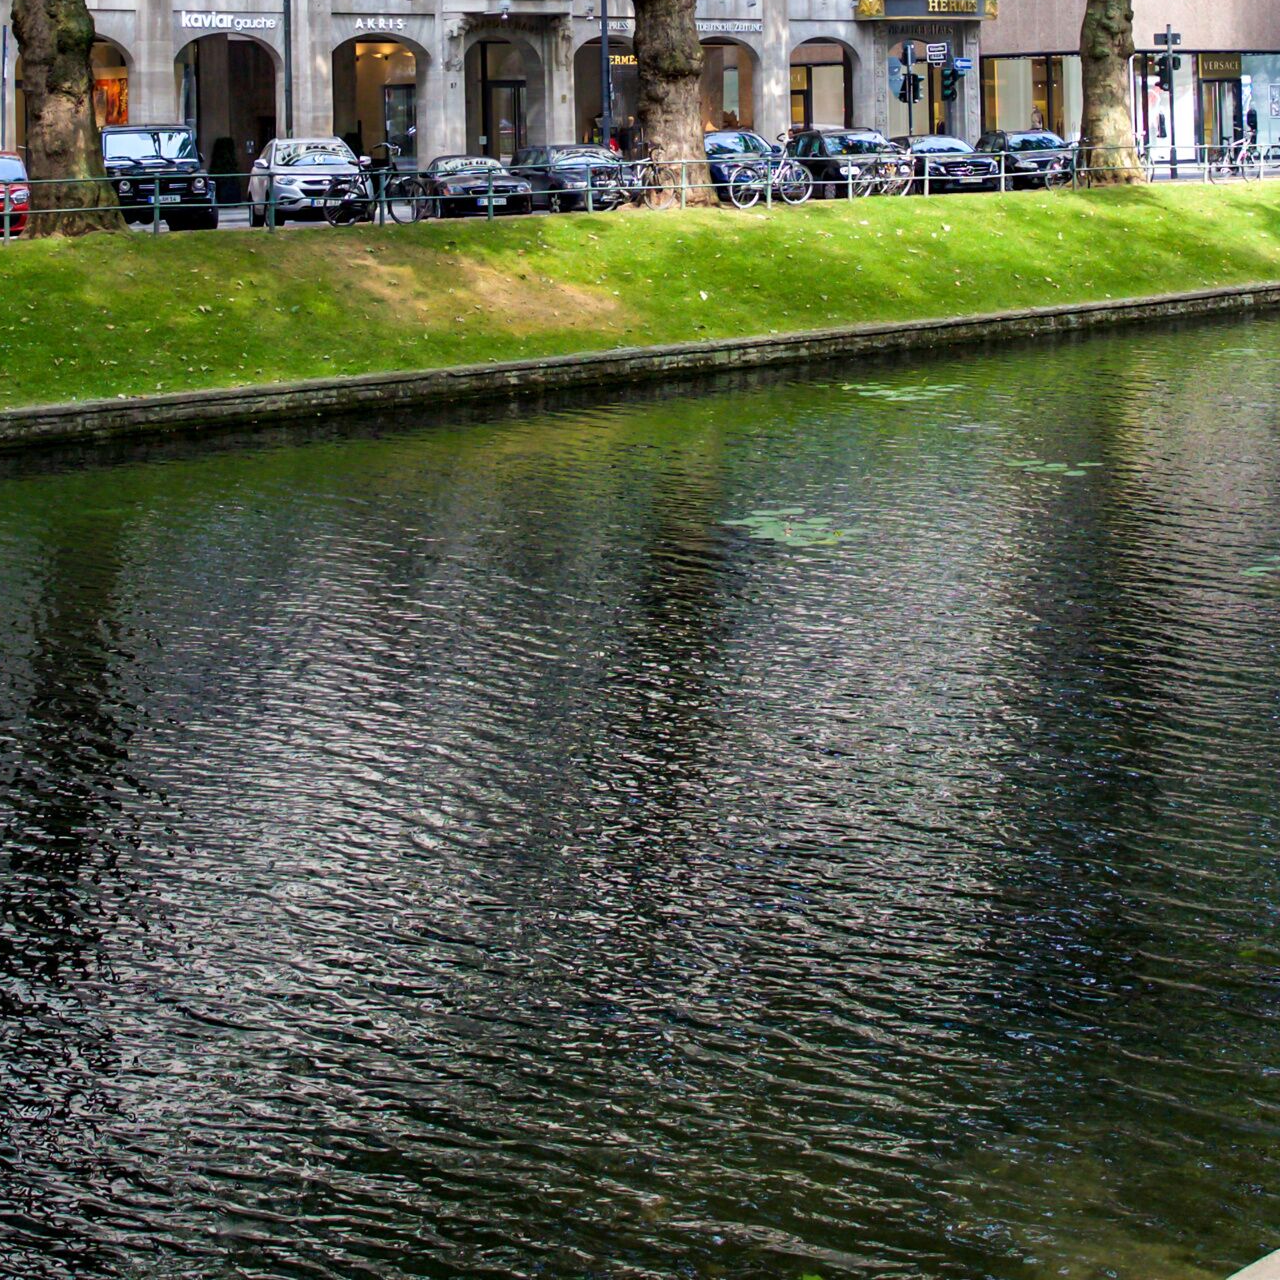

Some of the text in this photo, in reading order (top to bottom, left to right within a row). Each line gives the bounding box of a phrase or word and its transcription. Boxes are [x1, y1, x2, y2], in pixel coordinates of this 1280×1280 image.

[181, 10, 276, 31] kaviar gauche
[355, 17, 404, 29] AKRIS
